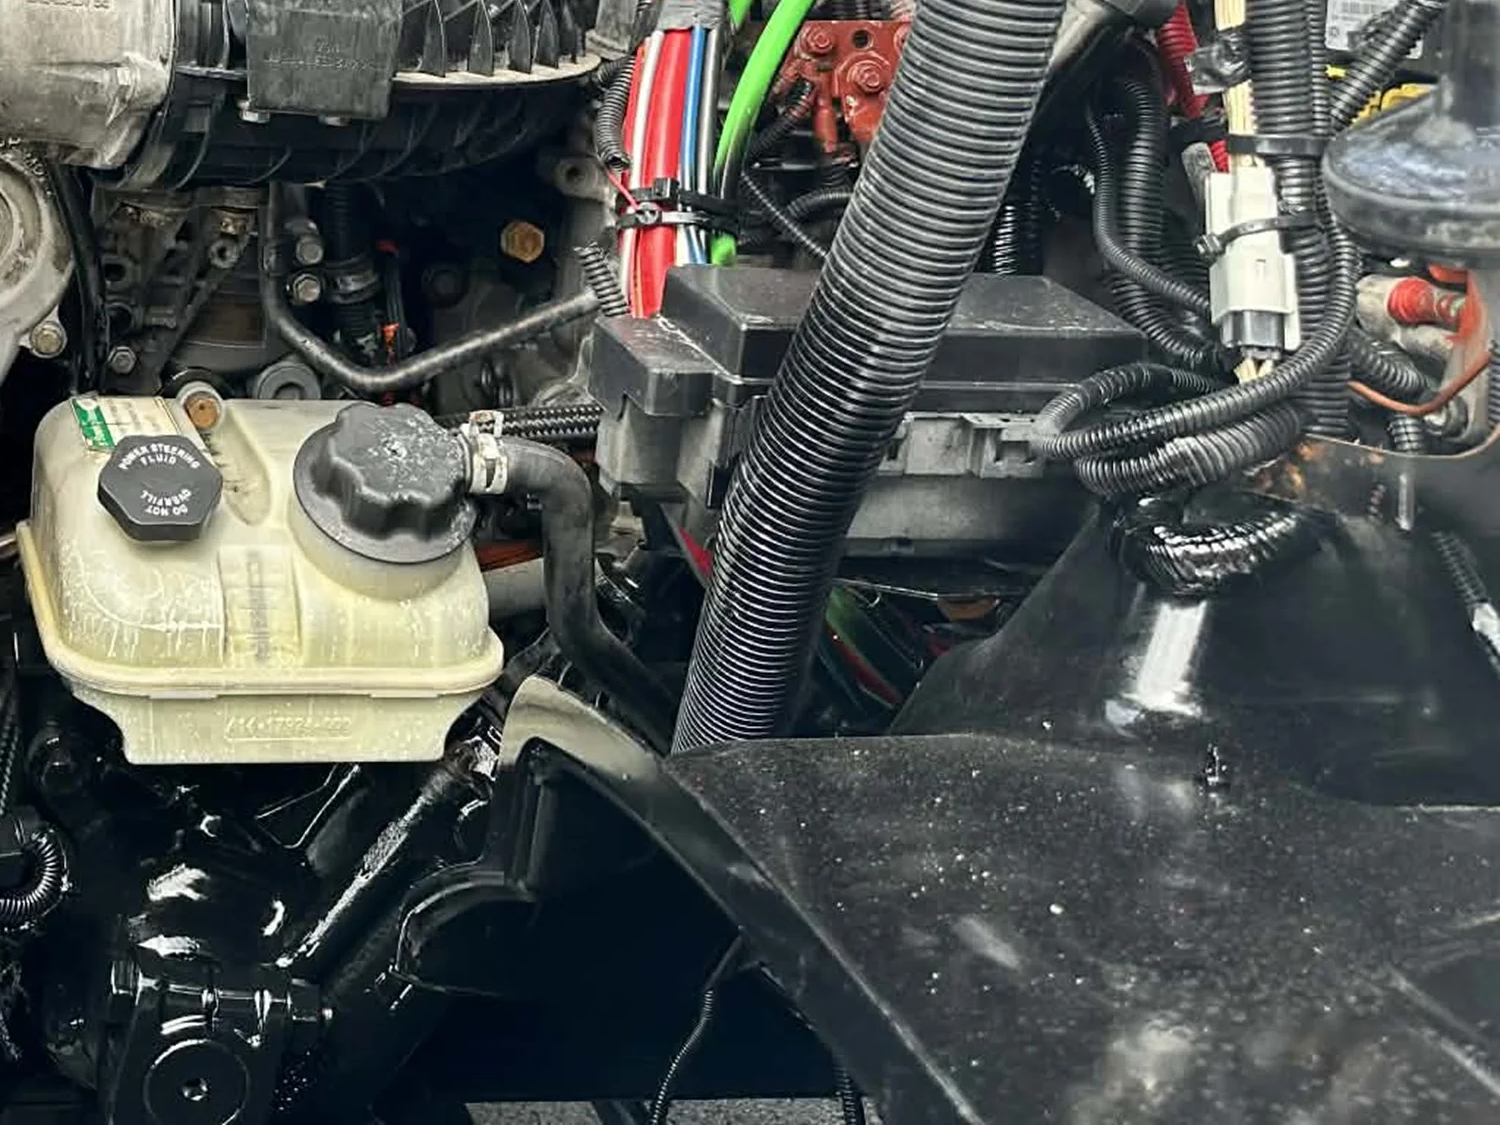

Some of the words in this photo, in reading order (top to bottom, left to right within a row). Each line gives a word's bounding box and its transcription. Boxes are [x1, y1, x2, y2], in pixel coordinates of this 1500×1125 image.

[118, 446, 149, 470] POWER
[149, 443, 201, 469] STEERING
[140, 453, 177, 466] FLUID
[140, 489, 192, 506] OVERFILL
[144, 505, 169, 516] NOT
[172, 504, 188, 516] DO
